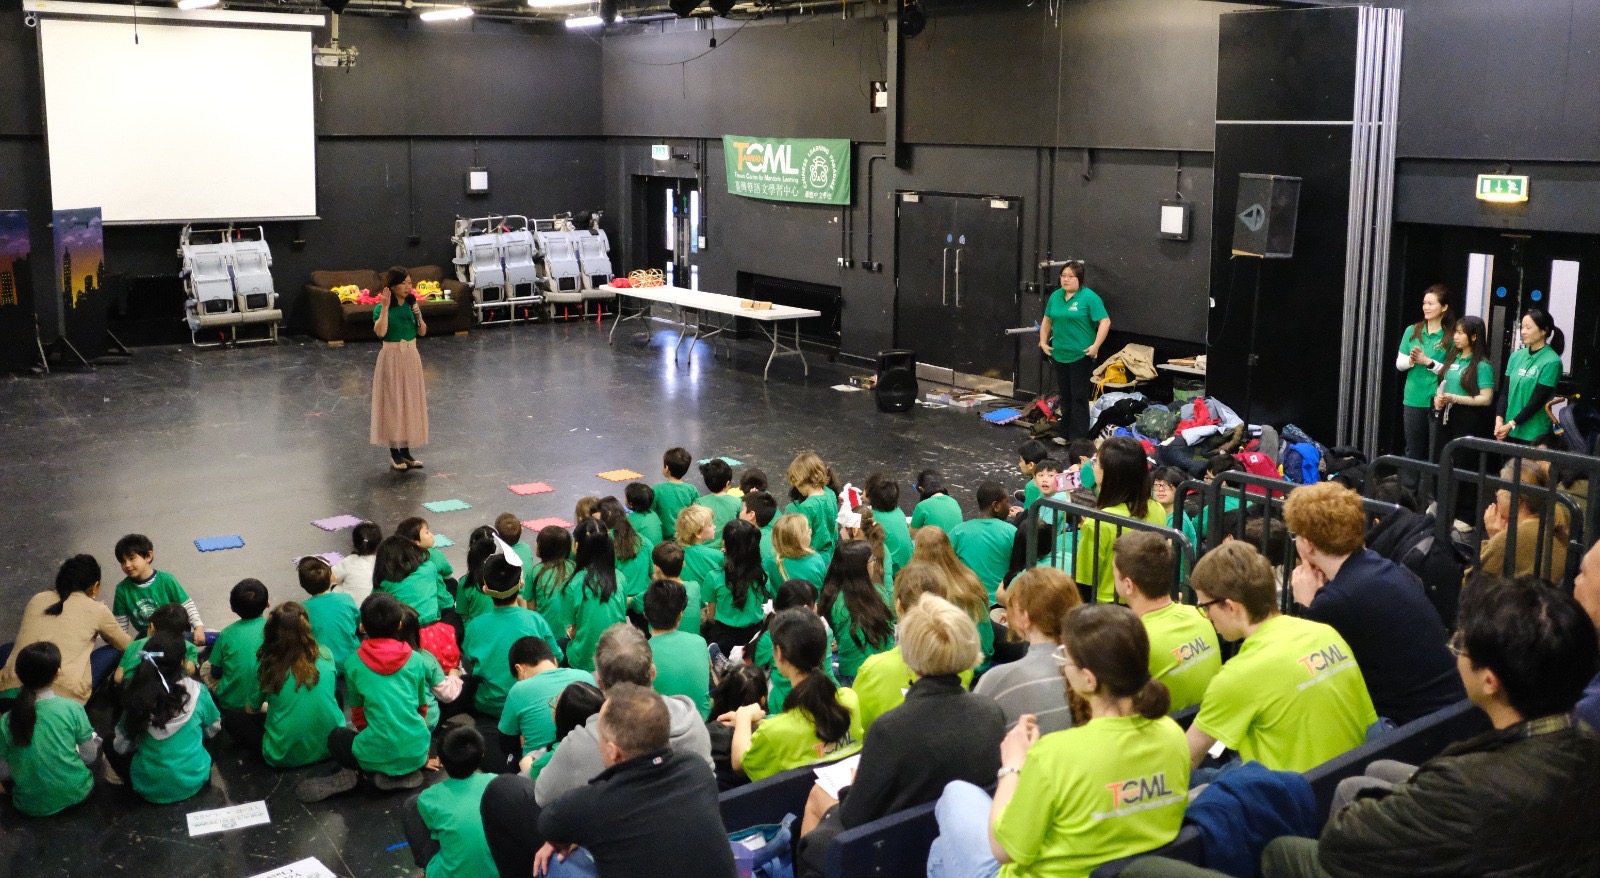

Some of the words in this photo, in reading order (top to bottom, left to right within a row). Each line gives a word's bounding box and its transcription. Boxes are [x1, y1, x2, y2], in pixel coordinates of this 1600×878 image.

[732, 141, 799, 175] TCML
[1171, 636, 1210, 666] TCML
[1298, 643, 1348, 676] TCML
[1106, 773, 1172, 809] TCML
